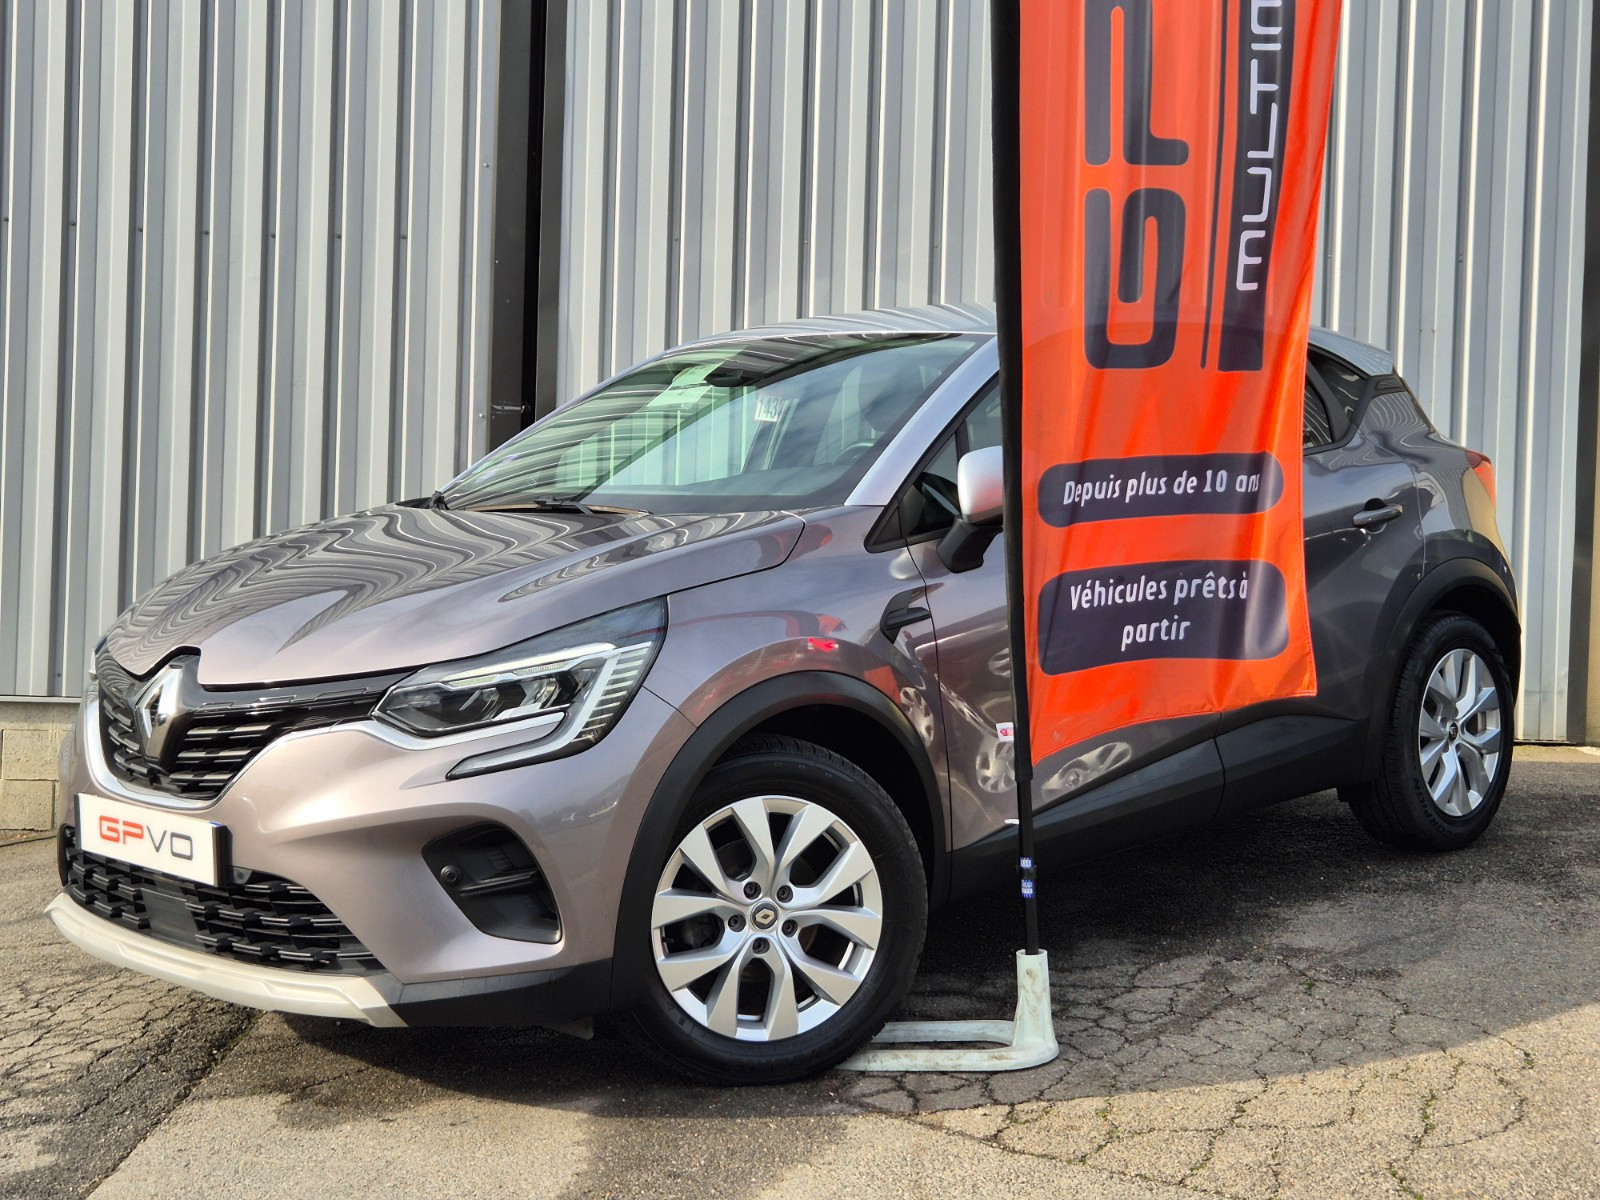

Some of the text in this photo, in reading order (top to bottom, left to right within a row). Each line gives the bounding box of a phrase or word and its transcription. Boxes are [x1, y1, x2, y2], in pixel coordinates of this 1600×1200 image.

[1063, 474, 1122, 507] Depuis
[1125, 471, 1168, 503] plus
[1173, 470, 1198, 495] de
[1202, 469, 1228, 493] 10
[1070, 575, 1168, 611] Véhicules
[1173, 570, 1237, 606] prêts
[1120, 614, 1191, 652] partir
[98, 815, 194, 861] GPVO
